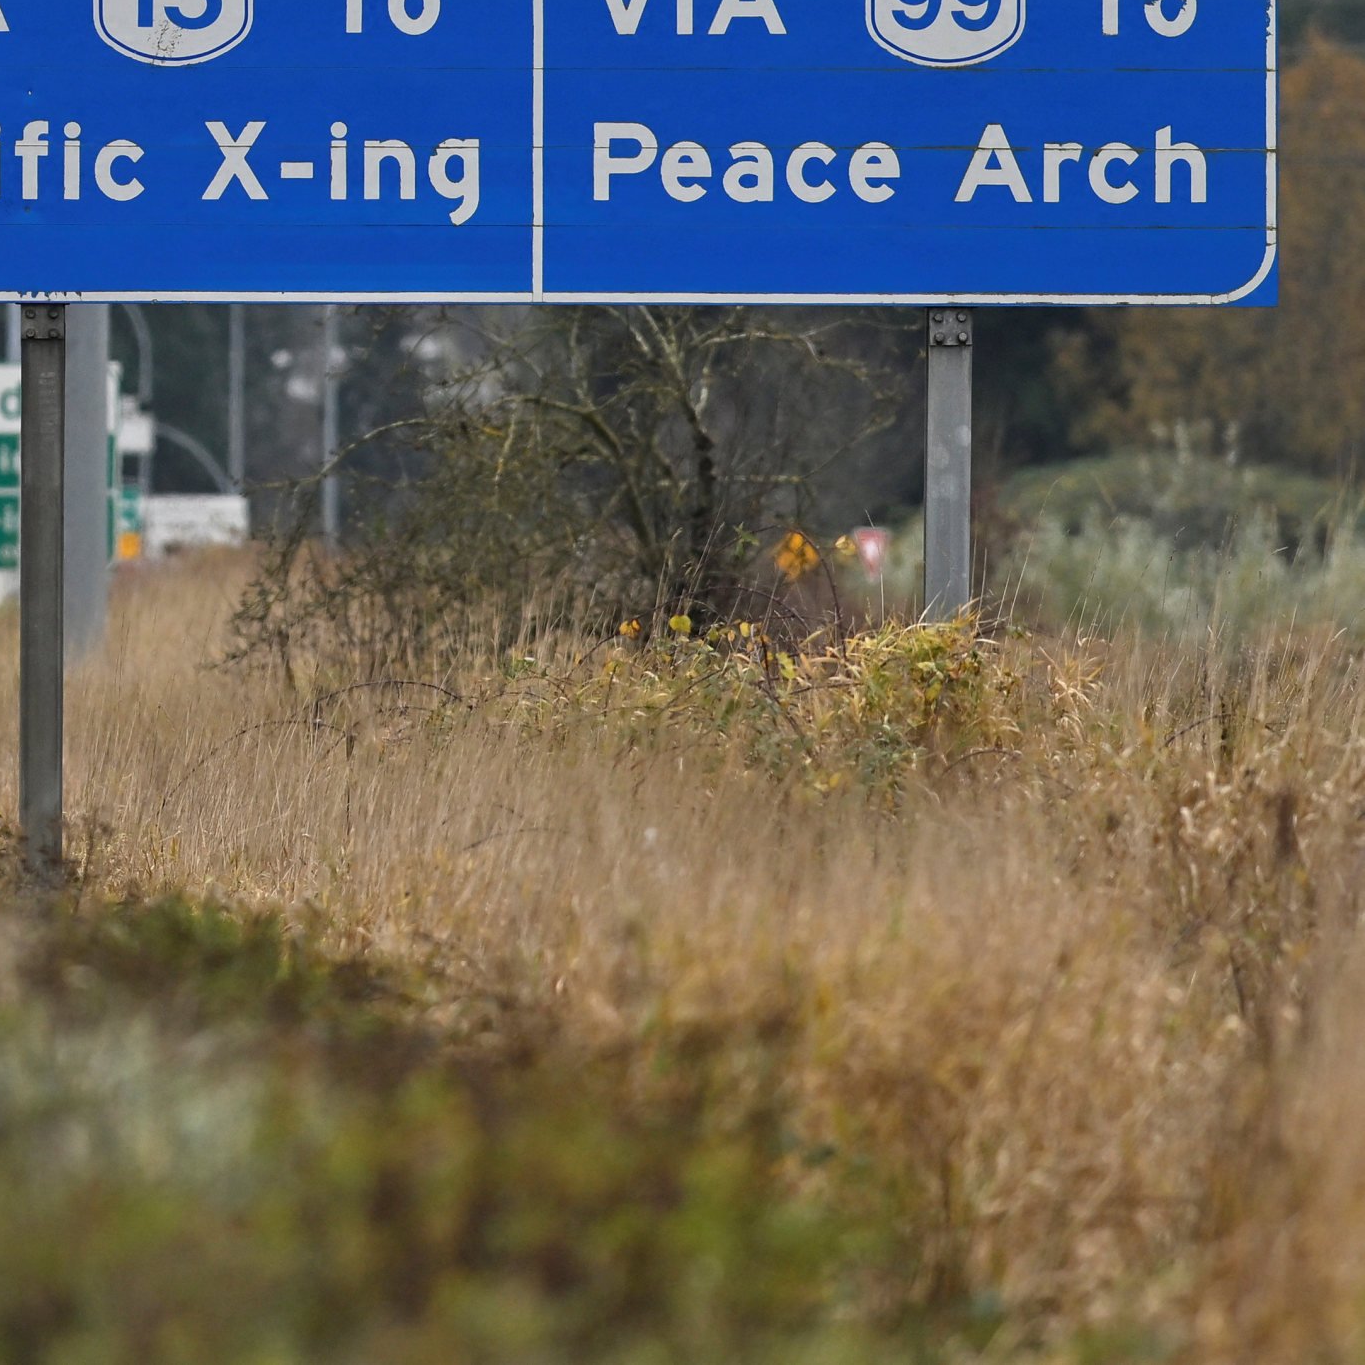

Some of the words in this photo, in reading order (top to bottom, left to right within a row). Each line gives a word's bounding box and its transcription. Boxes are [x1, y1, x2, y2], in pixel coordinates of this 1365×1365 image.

[202, 120, 480, 226] X-ing
[592, 122, 901, 203] Peace
[954, 123, 1207, 204] Arch
